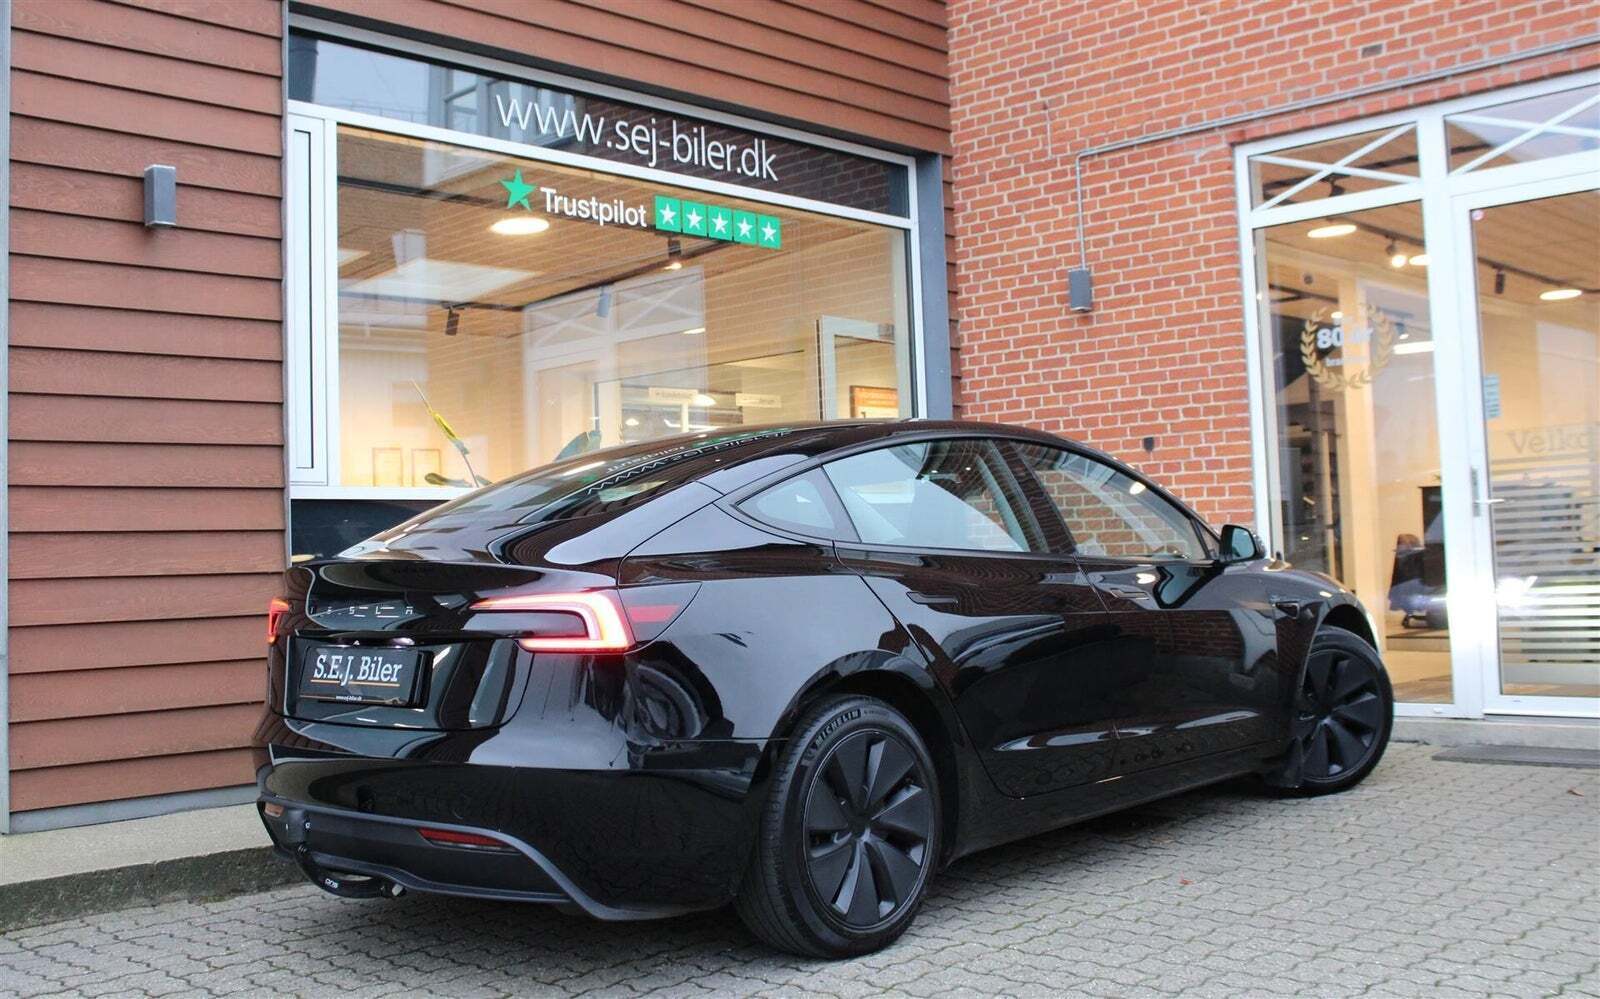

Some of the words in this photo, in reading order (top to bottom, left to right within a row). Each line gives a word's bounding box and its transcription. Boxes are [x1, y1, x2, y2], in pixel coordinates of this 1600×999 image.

[496, 94, 779, 182] www.sej-biler.dk
[540, 186, 647, 228] Trustpilot
[1316, 327, 1345, 349] 80
[313, 654, 354, 687] S.E.J.
[357, 656, 402, 682] Biler
[815, 709, 862, 747] MICHELIN
